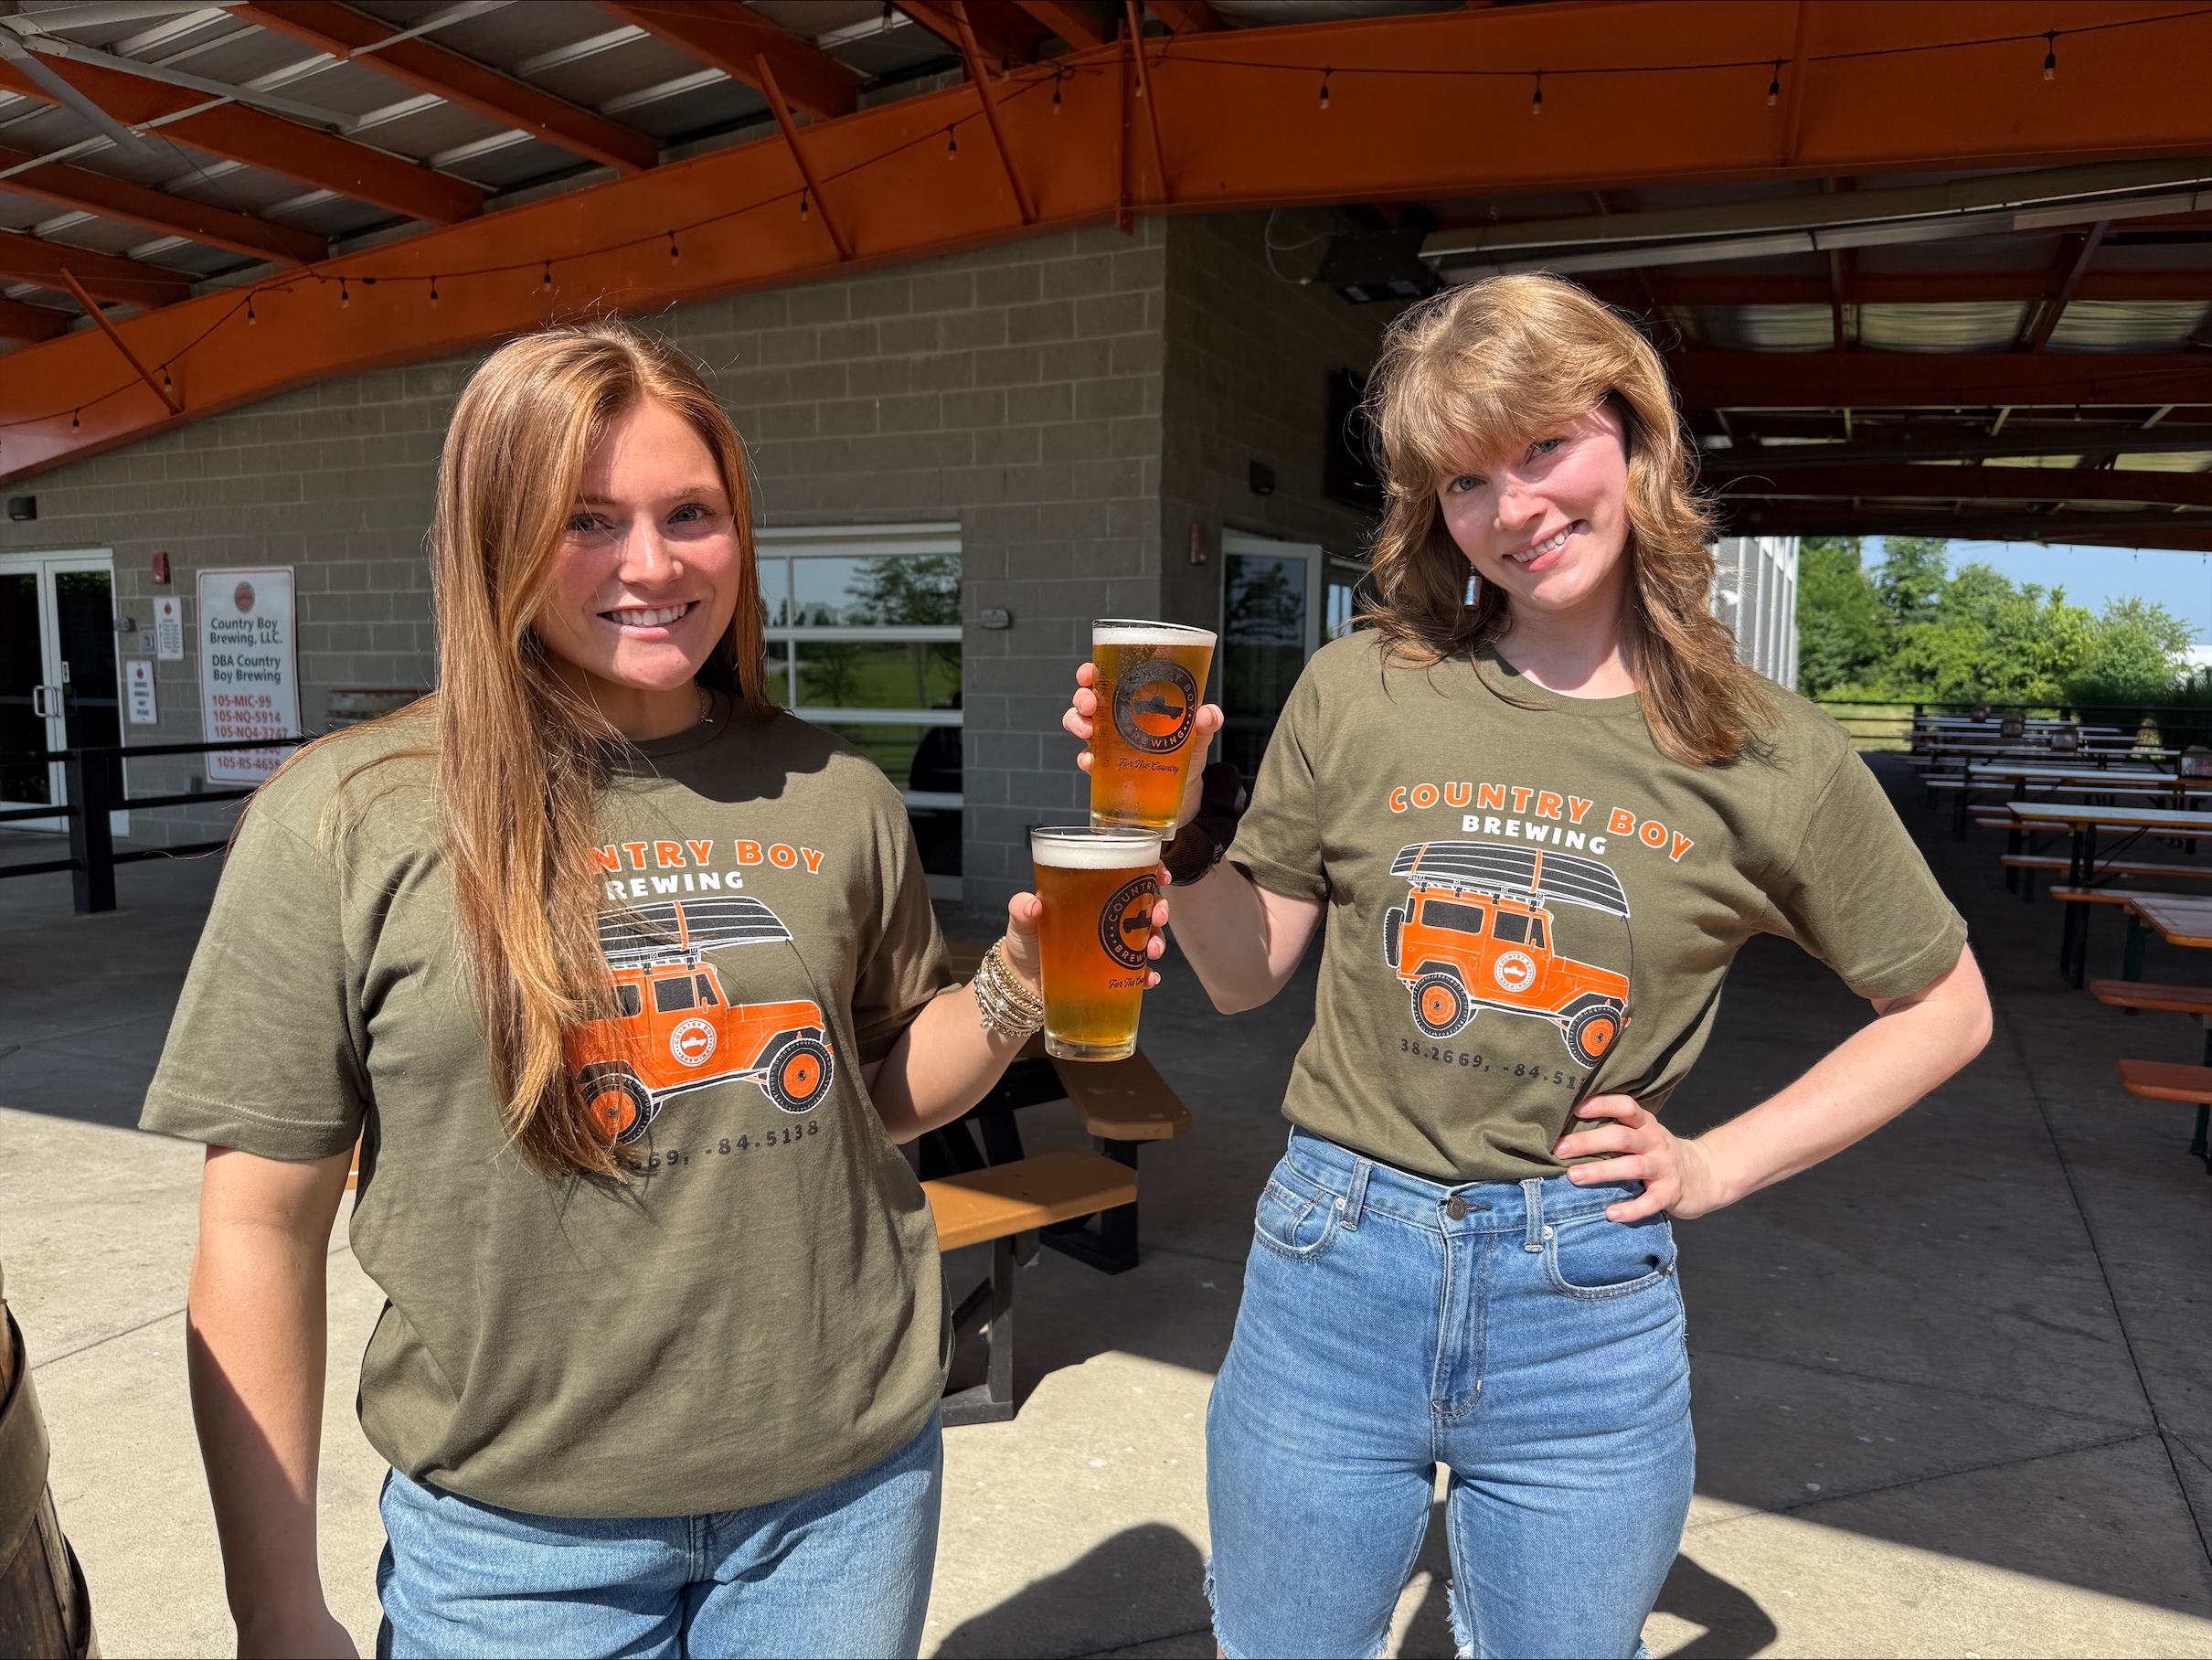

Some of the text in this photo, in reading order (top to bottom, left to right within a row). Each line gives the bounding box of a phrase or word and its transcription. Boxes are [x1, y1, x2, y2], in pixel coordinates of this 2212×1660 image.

[211, 617, 278, 632] Country Boy
[210, 632, 282, 646] Brewing, LLC.
[212, 654, 281, 670] DBA Country
[213, 669, 281, 685] Boy Brewing
[212, 695, 271, 708] 105-MIC-99
[1184, 683, 1195, 712] BOY
[1124, 723, 1185, 748] BREWING
[1118, 758, 1180, 775] For The Country
[1388, 782, 1694, 862] COUNTRY BOY
[1462, 815, 1607, 855] BREWING
[588, 839, 824, 875] NTRY BOY
[605, 871, 744, 900] REWING
[1108, 979, 1122, 988] For
[675, 1022, 713, 1044] COUNTRY BOY
[1400, 1038, 1490, 1072] 38.2669,
[705, 1120, 819, 1155] -84.5138
